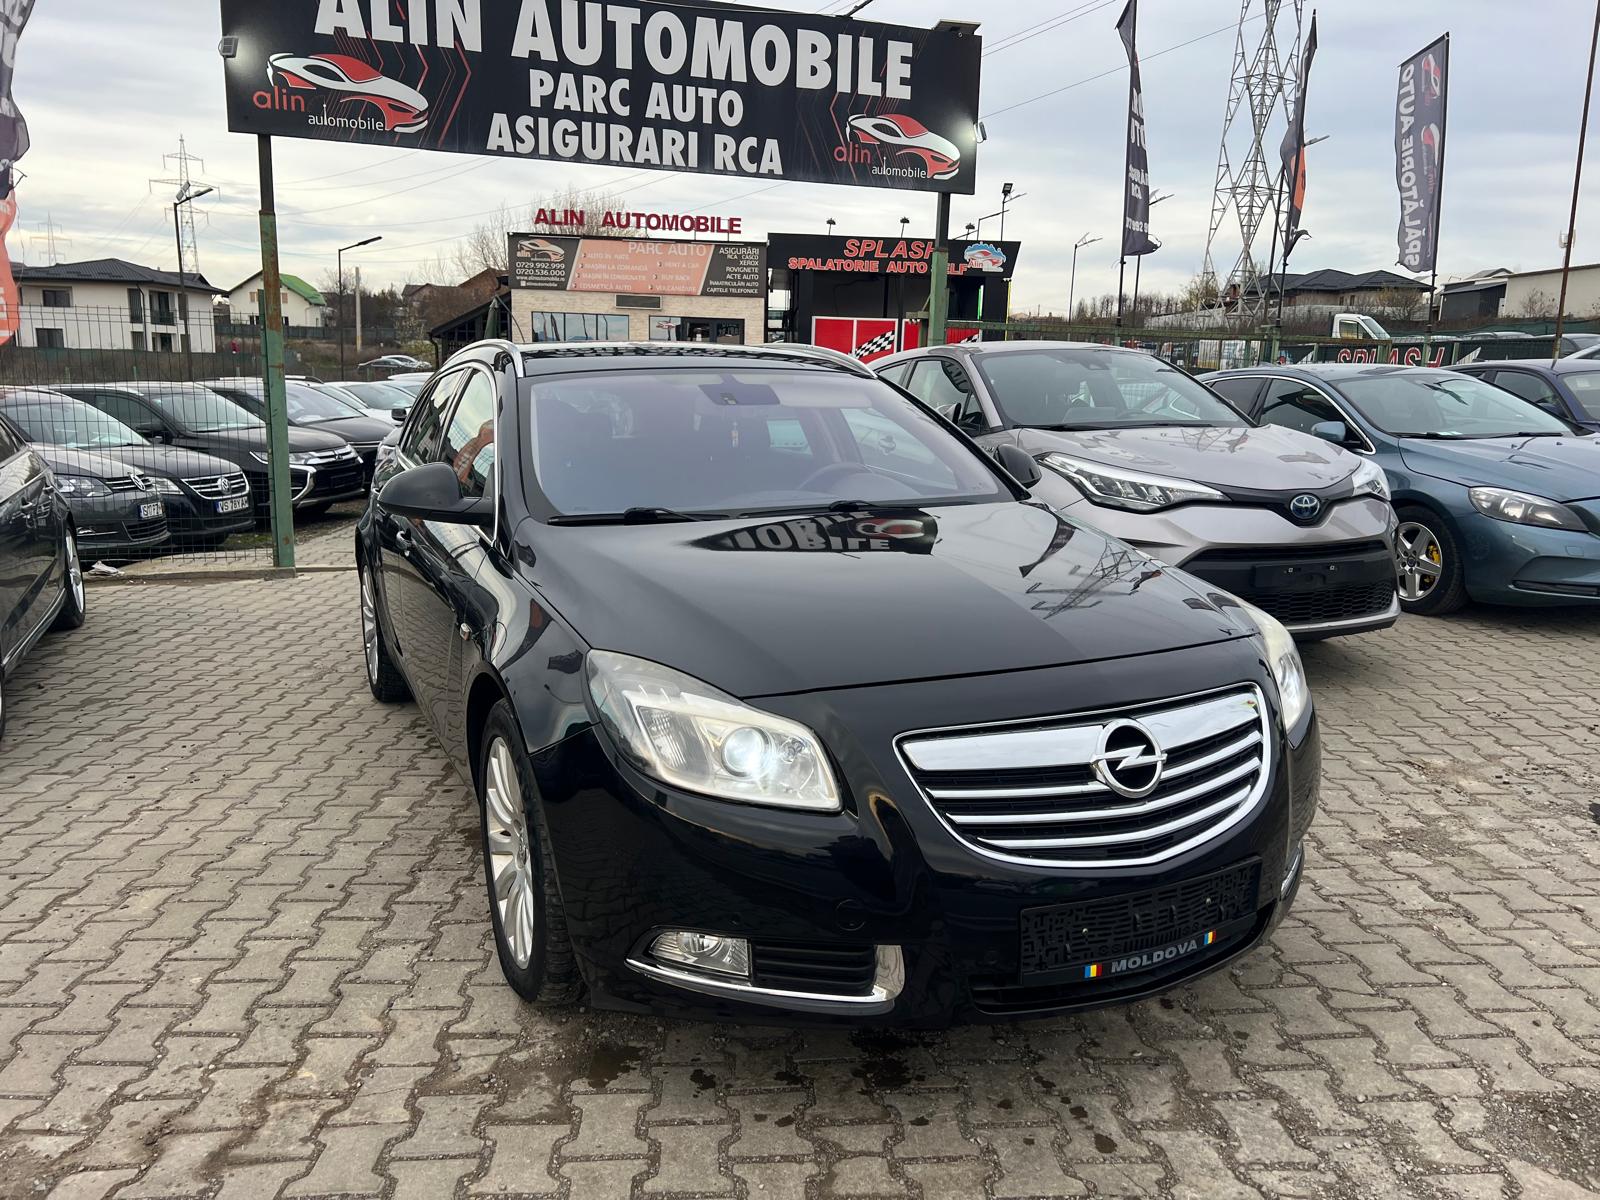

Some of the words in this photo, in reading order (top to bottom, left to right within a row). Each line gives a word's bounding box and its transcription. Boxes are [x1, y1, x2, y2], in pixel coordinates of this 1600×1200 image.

[314, 0, 482, 52] ALIN
[511, 0, 913, 100] AUTOMOBILE
[253, 86, 305, 112] alin
[529, 69, 630, 116] PARC
[645, 82, 744, 127] AUTO
[486, 113, 699, 168] ASIGURARI
[714, 134, 783, 175] RCA
[833, 146, 871, 164] alin
[534, 208, 585, 226] ALIN
[601, 211, 742, 235] AUTOMOBILE
[628, 241, 664, 255] PARC
[667, 243, 706, 257] AUTO
[788, 257, 879, 273] SPALATORIE
[886, 260, 928, 274] AUTO
[1110, 939, 1199, 974] MOLDOVA
